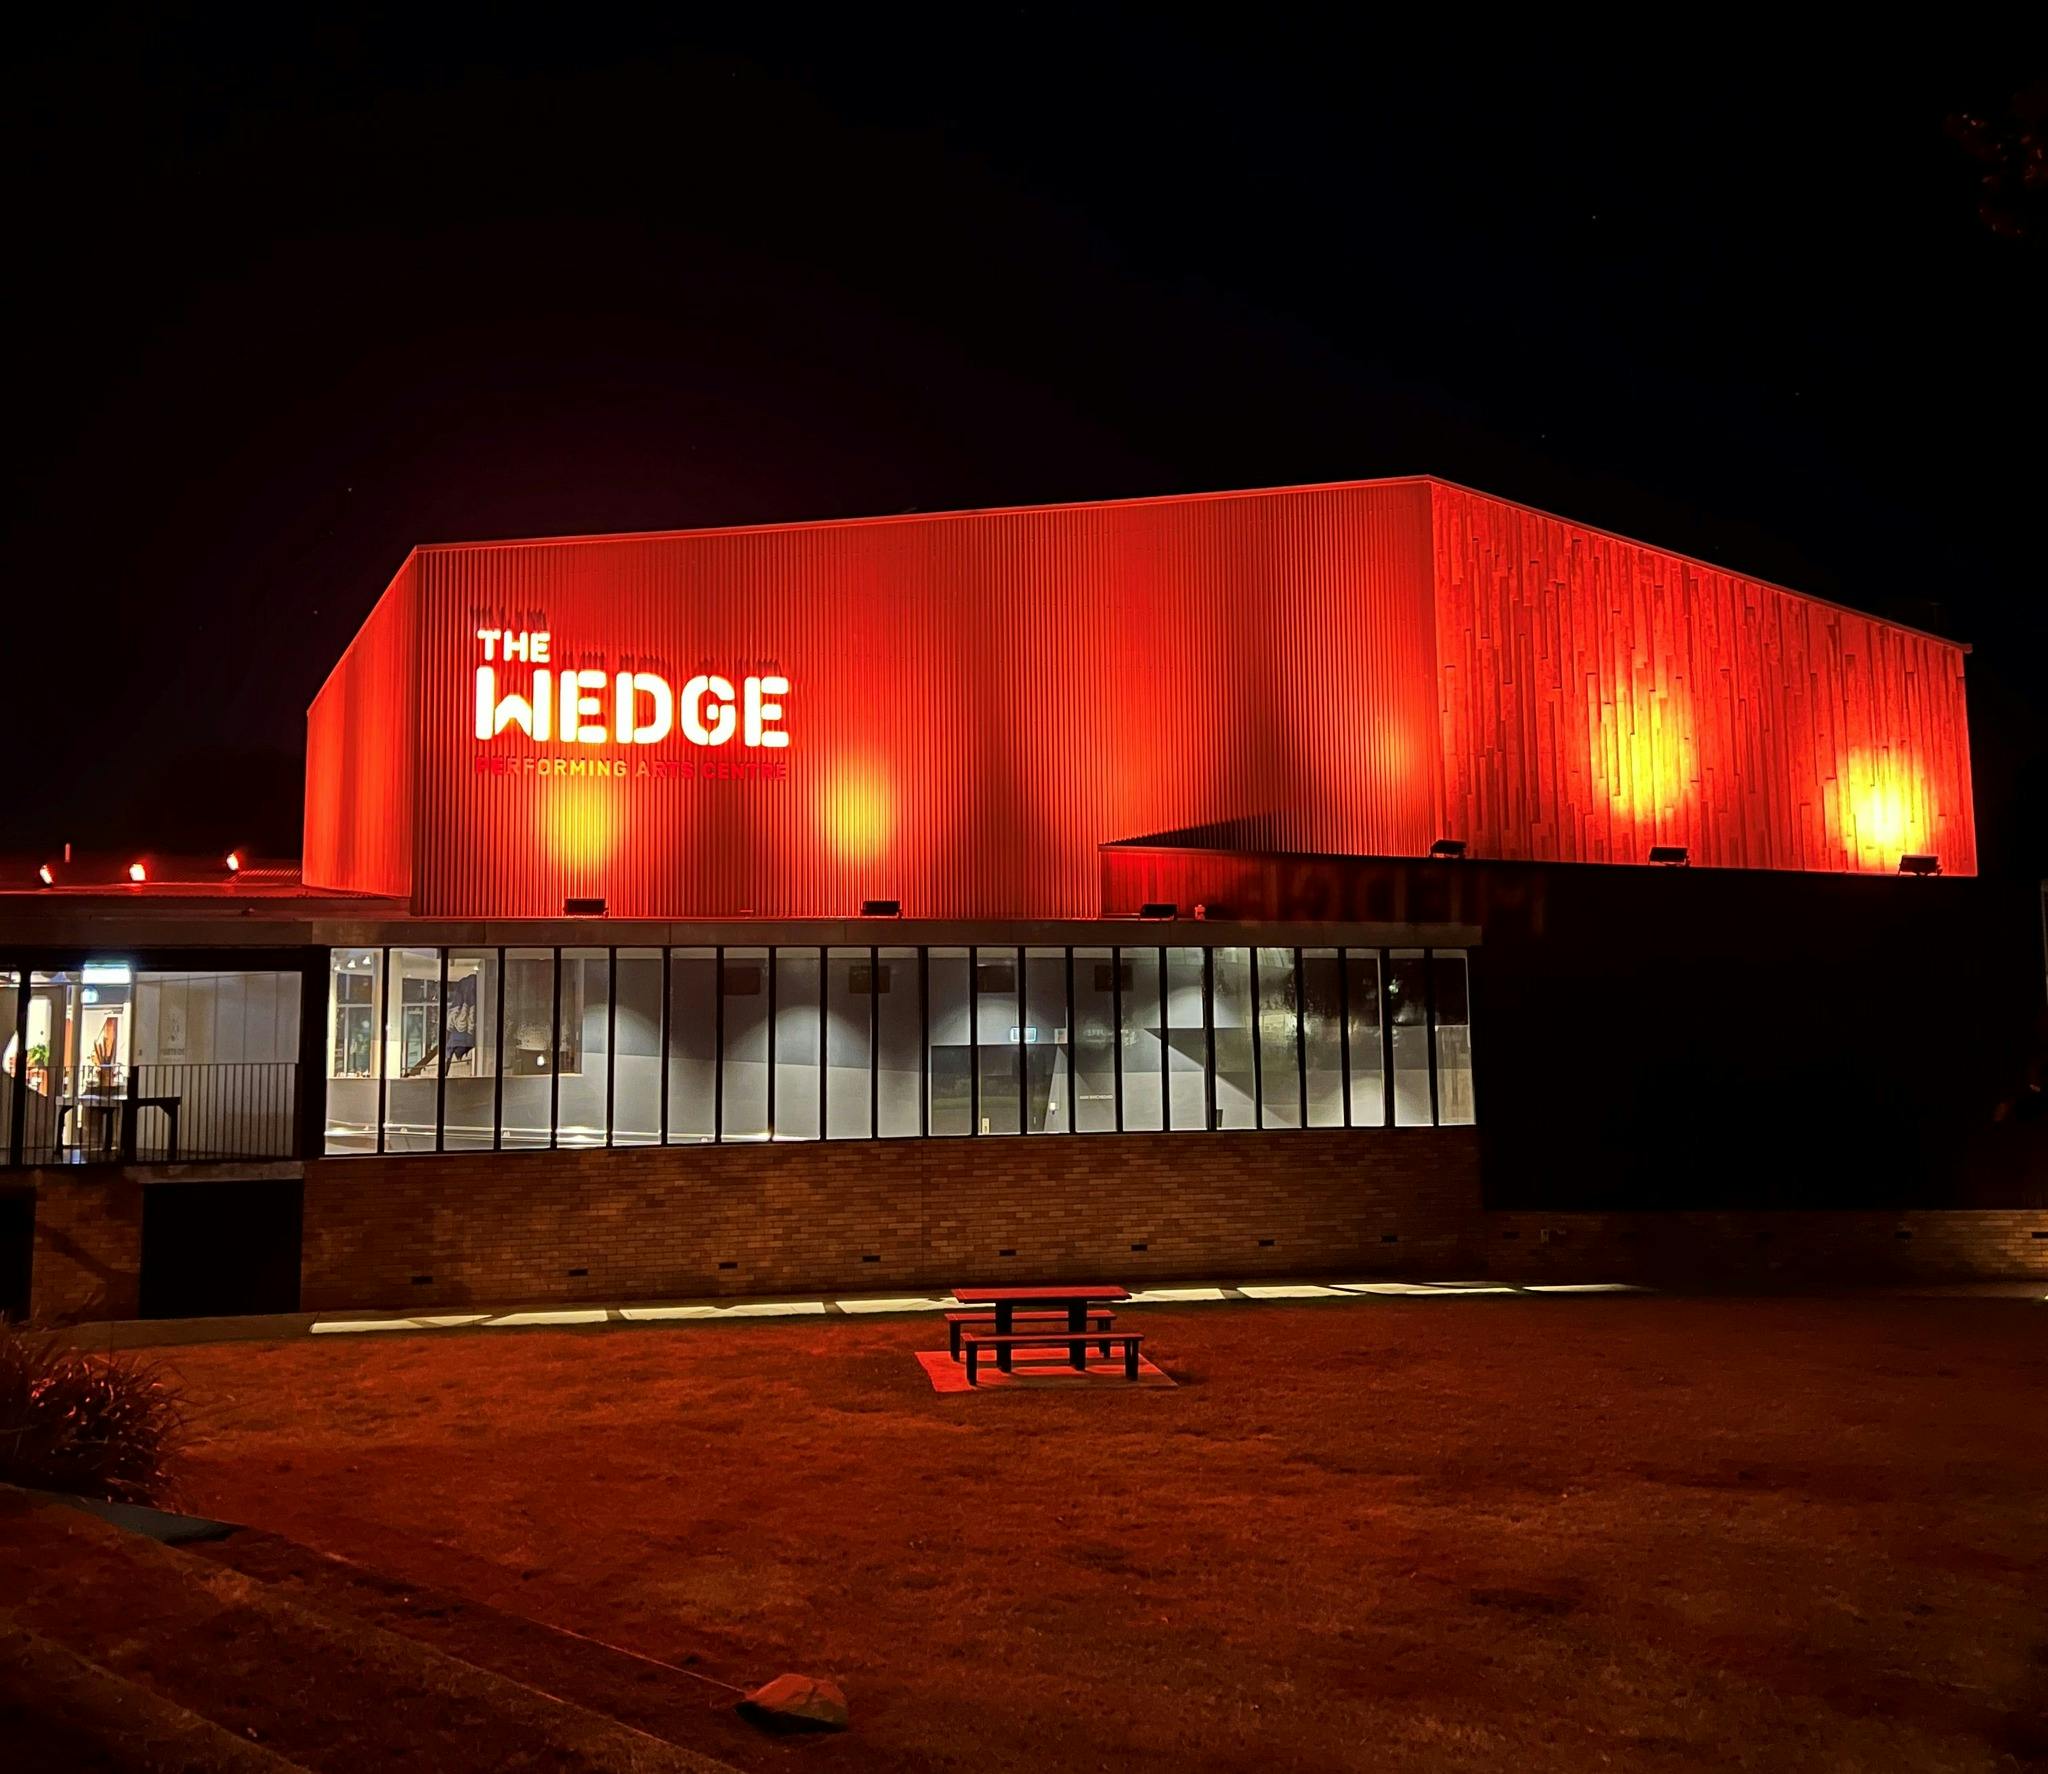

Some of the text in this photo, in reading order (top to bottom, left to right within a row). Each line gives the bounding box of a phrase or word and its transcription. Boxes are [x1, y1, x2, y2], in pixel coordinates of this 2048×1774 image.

[477, 629, 550, 662] THE
[475, 666, 789, 747] WEDGE
[475, 757, 787, 781] PERFORMING ARTS CENTRE
